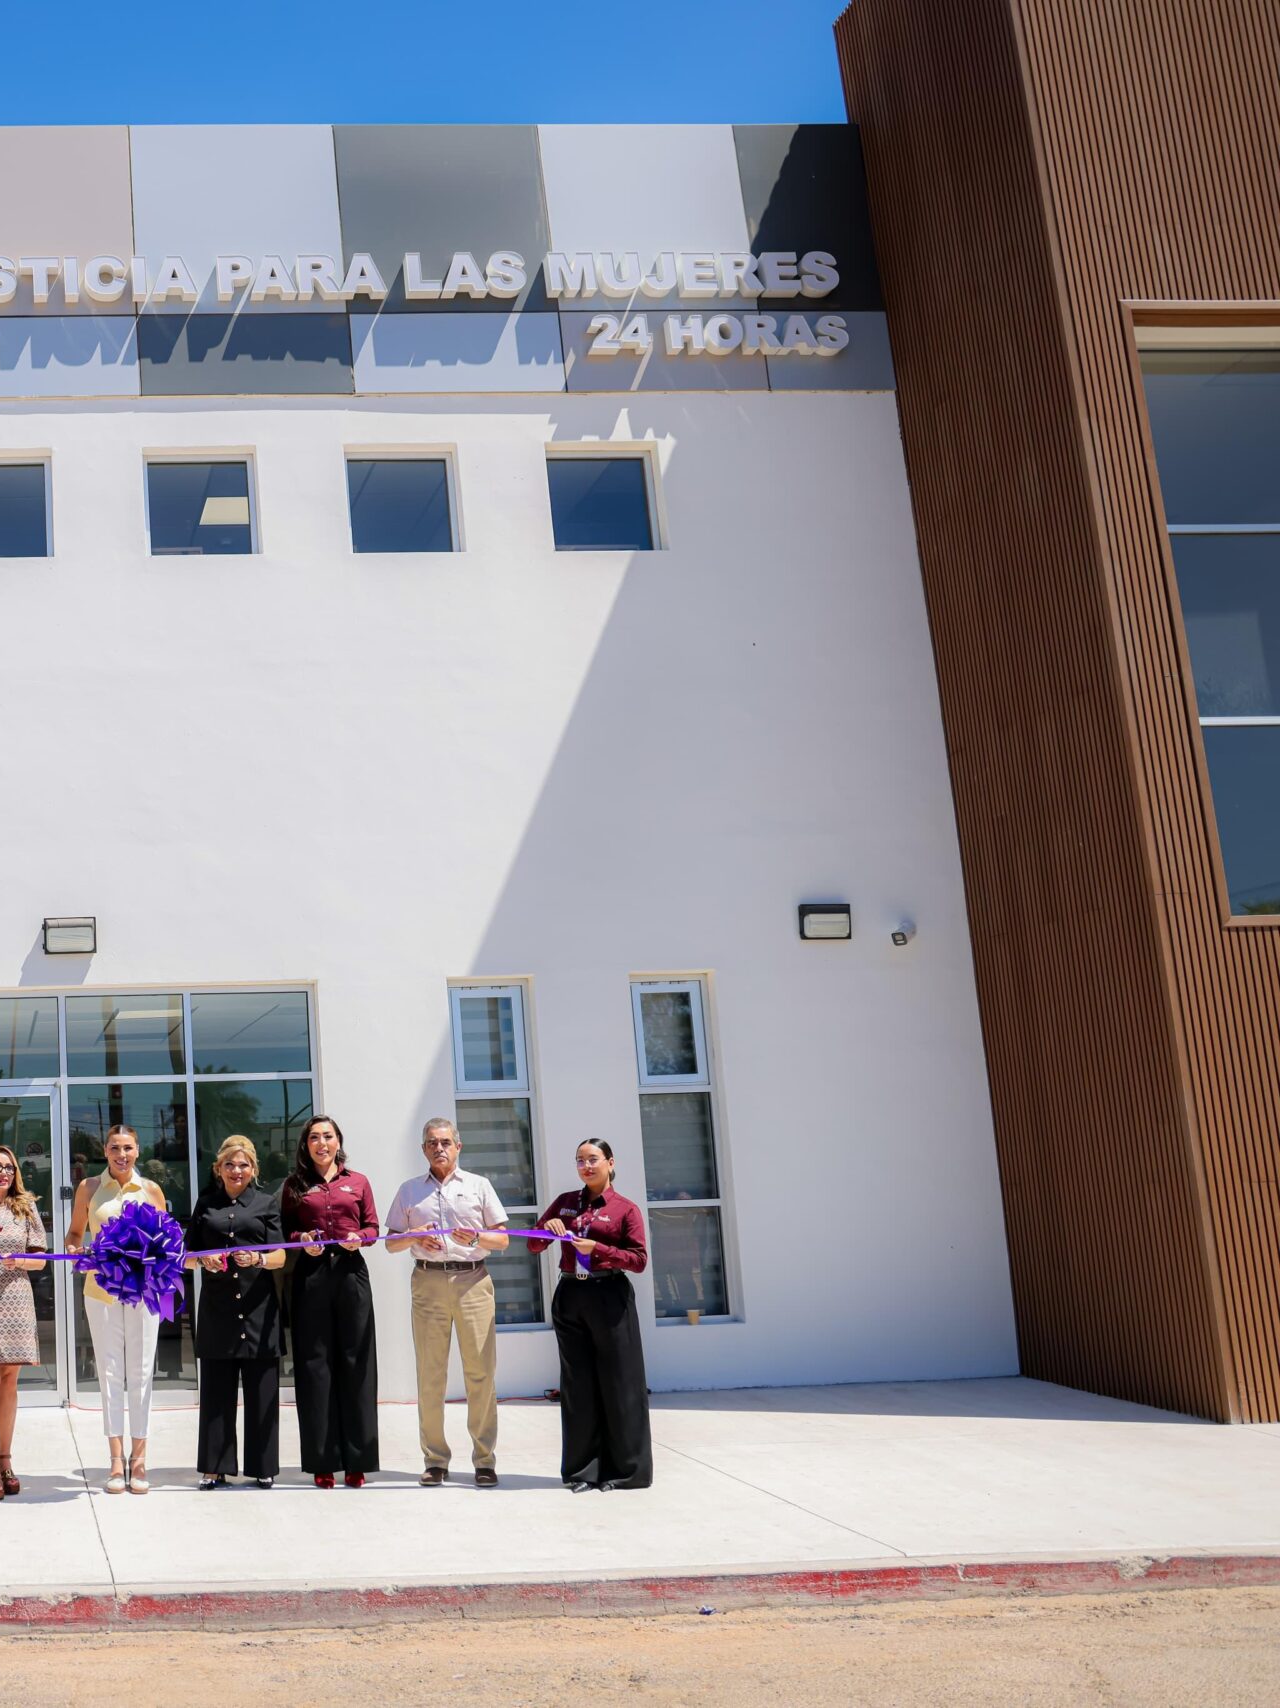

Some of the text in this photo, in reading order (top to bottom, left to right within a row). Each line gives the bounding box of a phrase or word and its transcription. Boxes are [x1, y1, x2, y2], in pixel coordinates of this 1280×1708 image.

[216, 253, 388, 300] PARA
[402, 251, 527, 299] LAS
[546, 251, 840, 299] MUJERES
[586, 314, 850, 356] 24 HORAS
